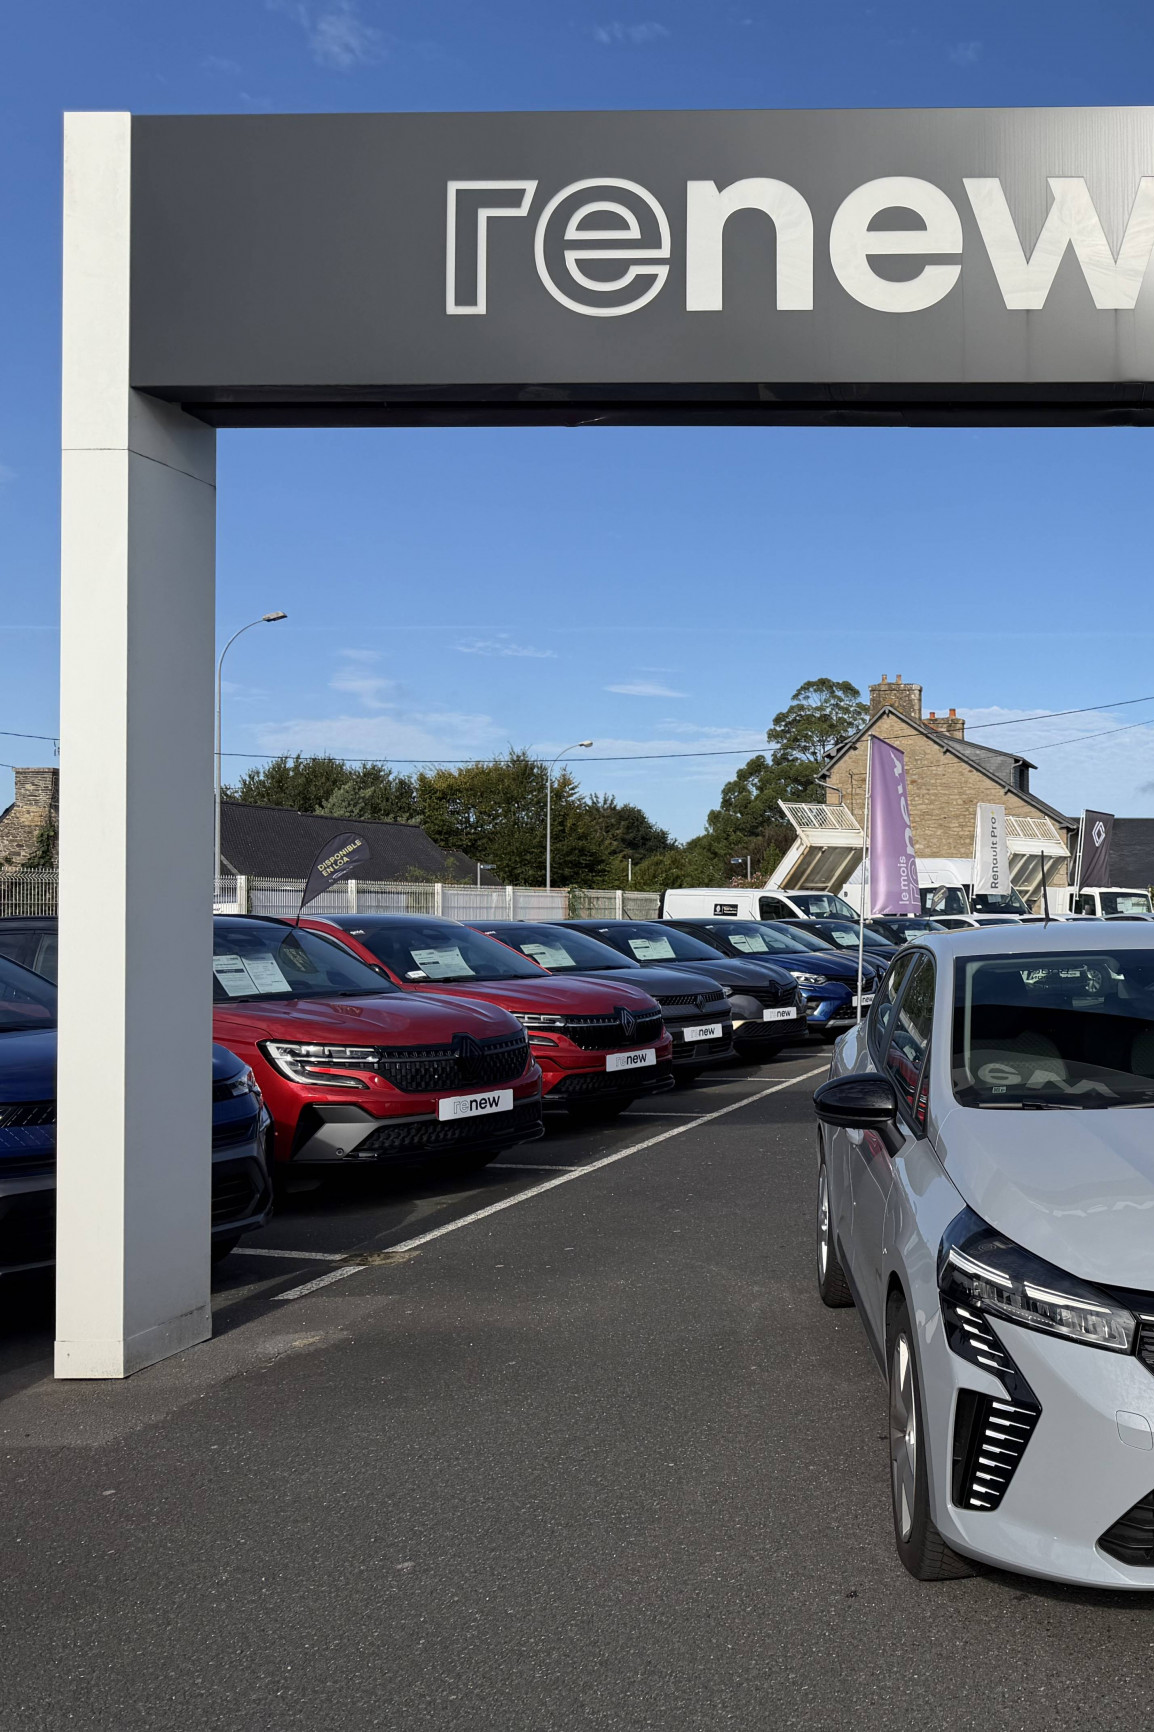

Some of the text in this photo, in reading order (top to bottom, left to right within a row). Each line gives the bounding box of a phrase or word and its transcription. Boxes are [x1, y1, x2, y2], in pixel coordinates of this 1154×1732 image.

[317, 839, 362, 871] DISPONIBLE
[322, 866, 335, 877] EN
[332, 856, 350, 870] LOA
[990, 840, 999, 889] Renault
[897, 855, 909, 904] le mois
[453, 1095, 501, 1115] renew
